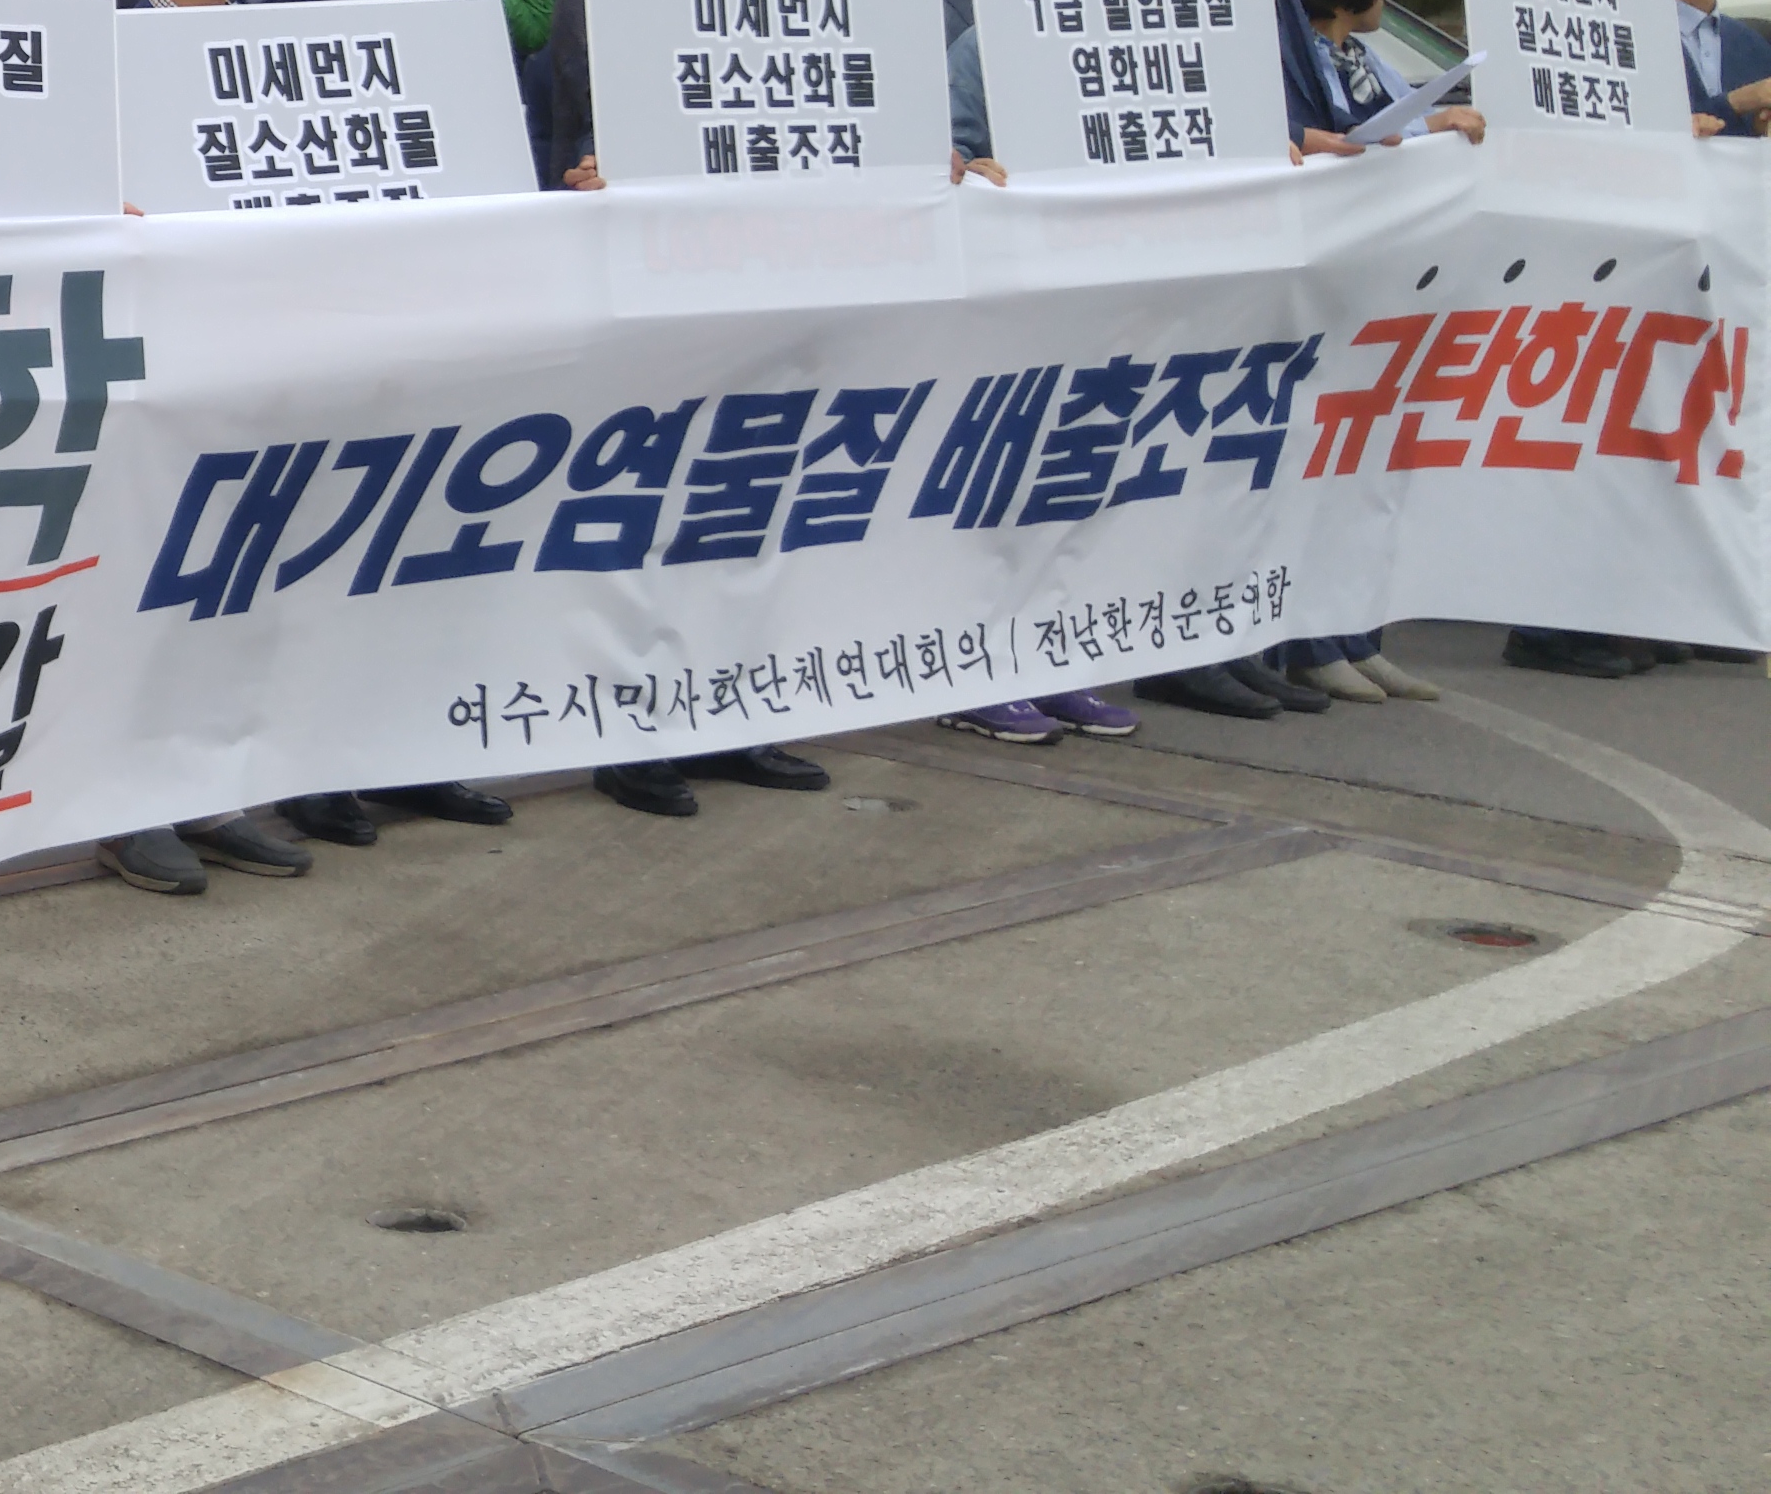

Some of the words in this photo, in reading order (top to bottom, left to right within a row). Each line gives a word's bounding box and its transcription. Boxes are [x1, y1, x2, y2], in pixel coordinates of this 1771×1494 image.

[1514, 6, 1636, 70] 질소산화물
[206, 35, 402, 105] 미세먼지
[676, 53, 877, 109] 질소산화물
[1071, 41, 1208, 99] 염화비닐
[1531, 67, 1631, 126] 배출조작
[194, 109, 441, 183] 질소산화물
[701, 122, 863, 174] 배출조작
[1080, 107, 1215, 164] 배출조작
[137, 378, 938, 622] 대기오염물질
[909, 332, 1325, 530] 배출조작
[1302, 301, 1749, 485] 규탄한다!
[448, 627, 994, 749] 여수시민사회단체연대회의
[1035, 563, 1293, 668] 전남환경운동연합
